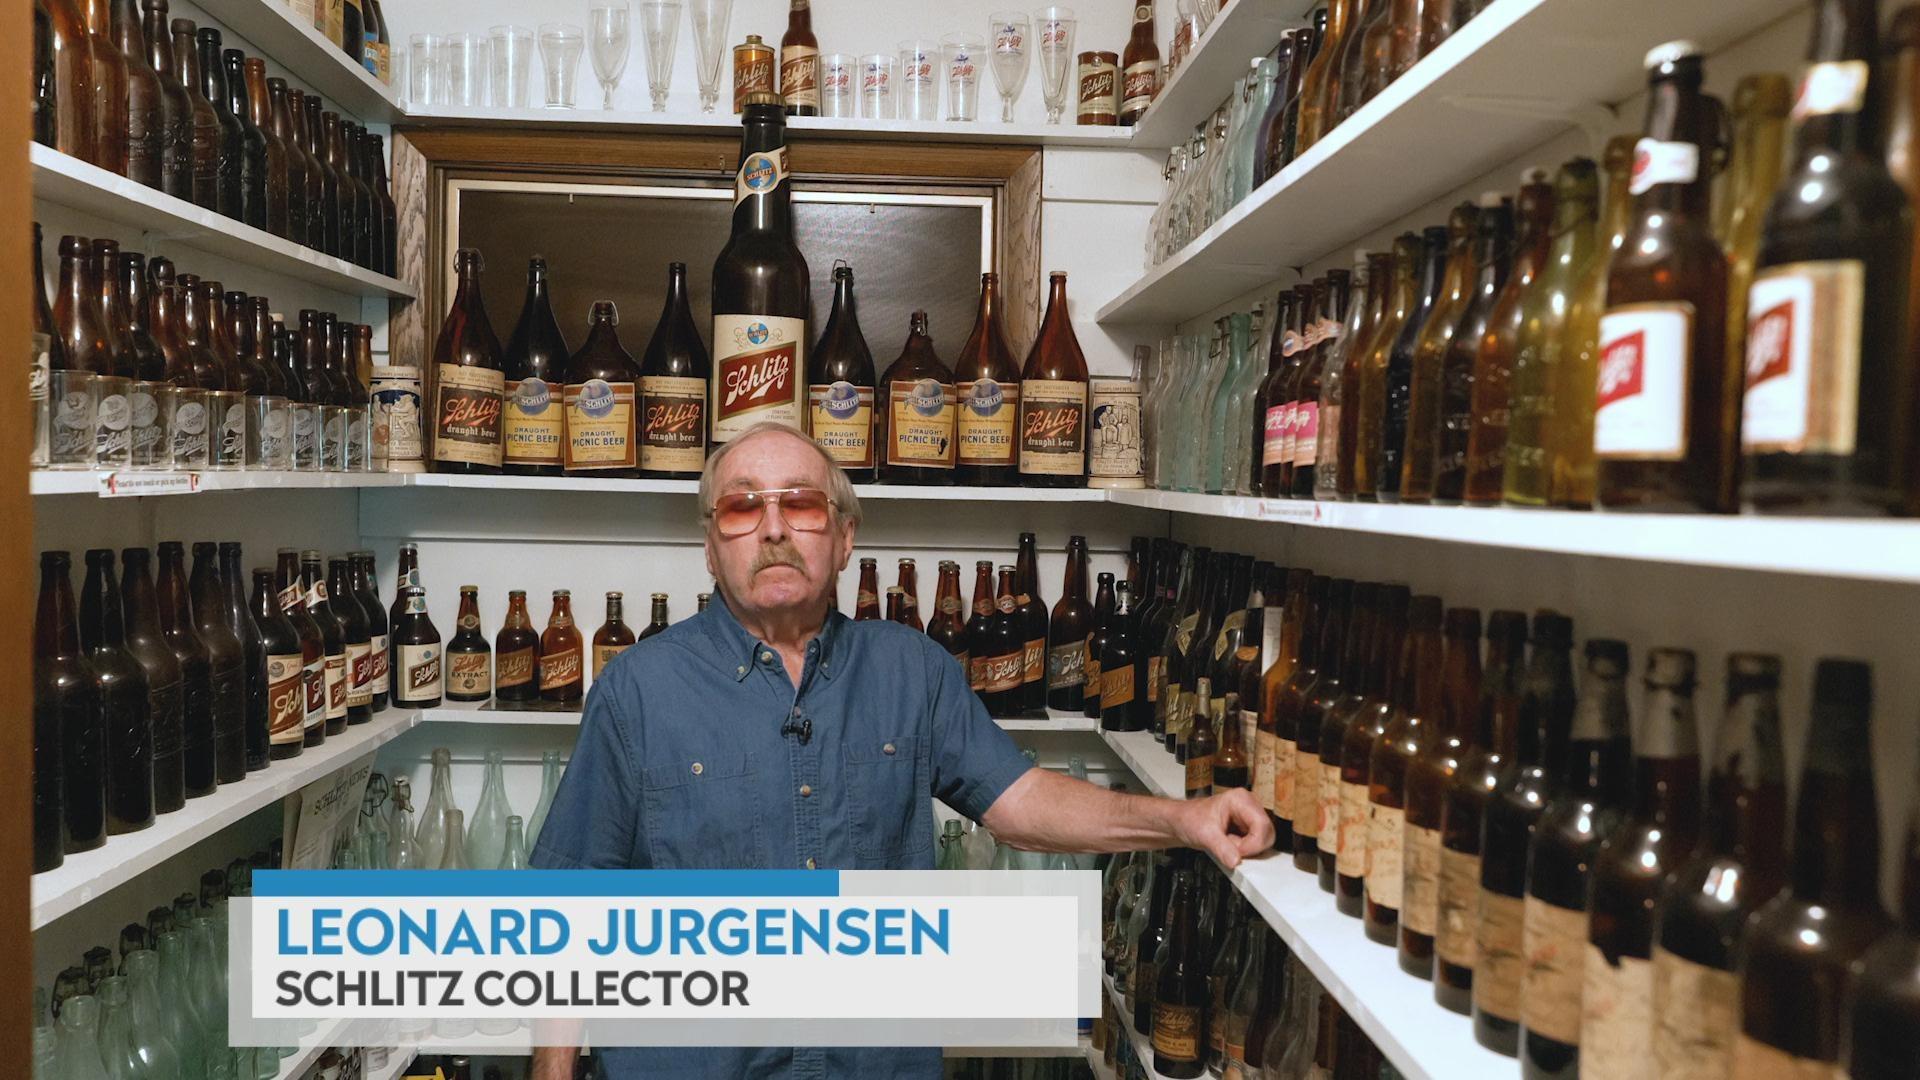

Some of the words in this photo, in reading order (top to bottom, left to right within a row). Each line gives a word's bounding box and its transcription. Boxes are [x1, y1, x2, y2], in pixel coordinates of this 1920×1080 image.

[725, 354, 789, 406] Schlitz
[442, 395, 500, 426] Schlitz
[646, 403, 700, 432] Schlitz
[1024, 408, 1078, 438] Schlitz
[447, 423, 478, 437] draught
[481, 426, 496, 438] beer
[648, 430, 677, 442] draught
[680, 432, 696, 442] beer
[506, 433, 533, 443] PICNIC
[536, 434, 559, 443] BEER
[572, 437, 600, 447] PICNIC
[603, 437, 625, 446] BEER
[846, 438, 866, 447] BEER
[899, 434, 928, 444] PICNIC
[960, 435, 987, 444] PICNIC
[990, 436, 1010, 444] BEER
[1027, 436, 1056, 448] draught
[1058, 437, 1075, 448] beer
[547, 655, 579, 680] Schlitz
